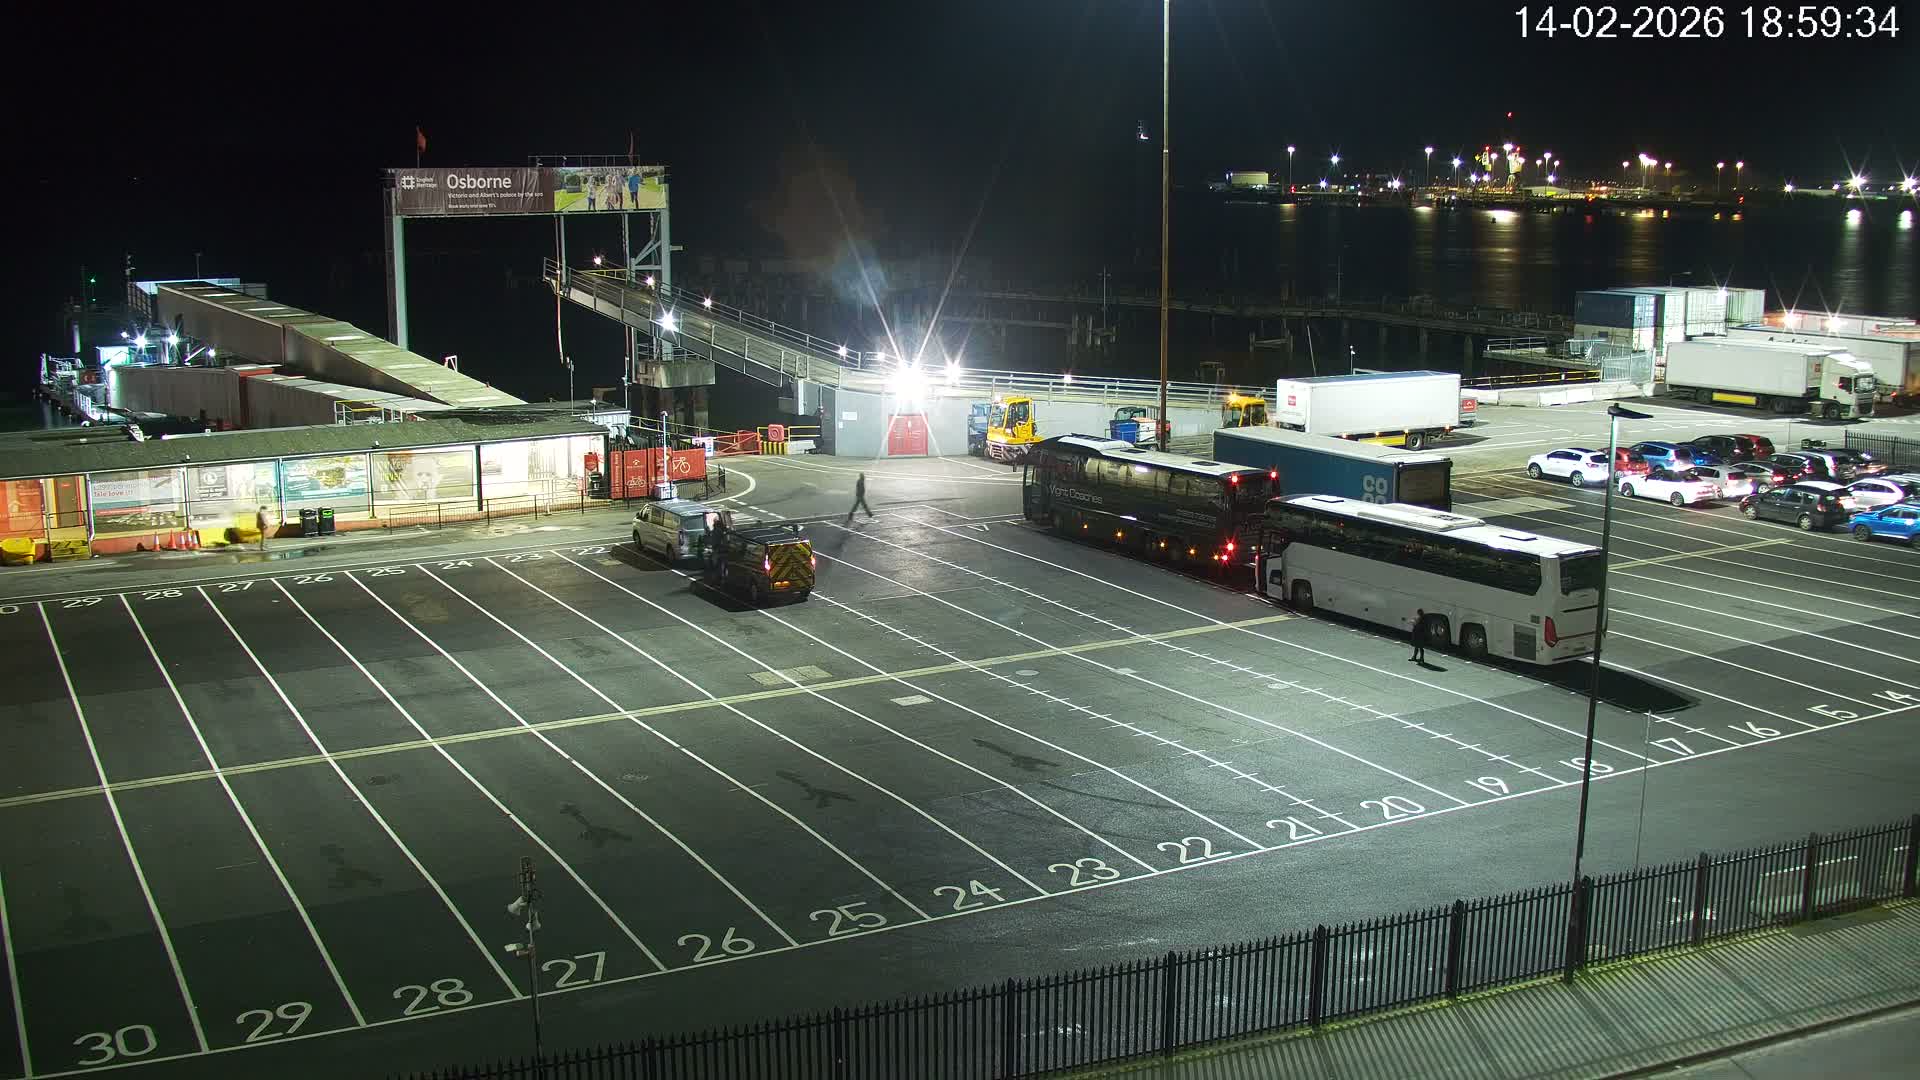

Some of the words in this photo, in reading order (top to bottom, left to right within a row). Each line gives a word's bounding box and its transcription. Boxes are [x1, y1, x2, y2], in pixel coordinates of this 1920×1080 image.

[446, 174, 512, 189] Osborne
[505, 552, 544, 563] 23
[571, 546, 611, 556] 22
[366, 565, 406, 577] 25
[437, 559, 474, 570] 24
[218, 581, 255, 593] 27
[293, 572, 334, 585] 26
[62, 597, 103, 609] 29
[142, 589, 185, 601] 28
[1872, 690, 1920, 706] 14
[1806, 704, 1859, 721] 15
[1728, 721, 1782, 739] 16
[1650, 737, 1696, 757] 17
[1559, 757, 1615, 776] 18
[1465, 776, 1510, 796] 19
[1359, 795, 1426, 820] 20
[1266, 816, 1323, 842] 21
[1157, 836, 1232, 864] 22
[1048, 858, 1121, 887] 23
[933, 879, 1006, 911] 24
[809, 902, 888, 937] 25
[677, 927, 756, 963] 26
[541, 951, 606, 989] 27
[393, 977, 474, 1016] 28
[235, 1001, 313, 1043] 29
[72, 1024, 158, 1066] 30
